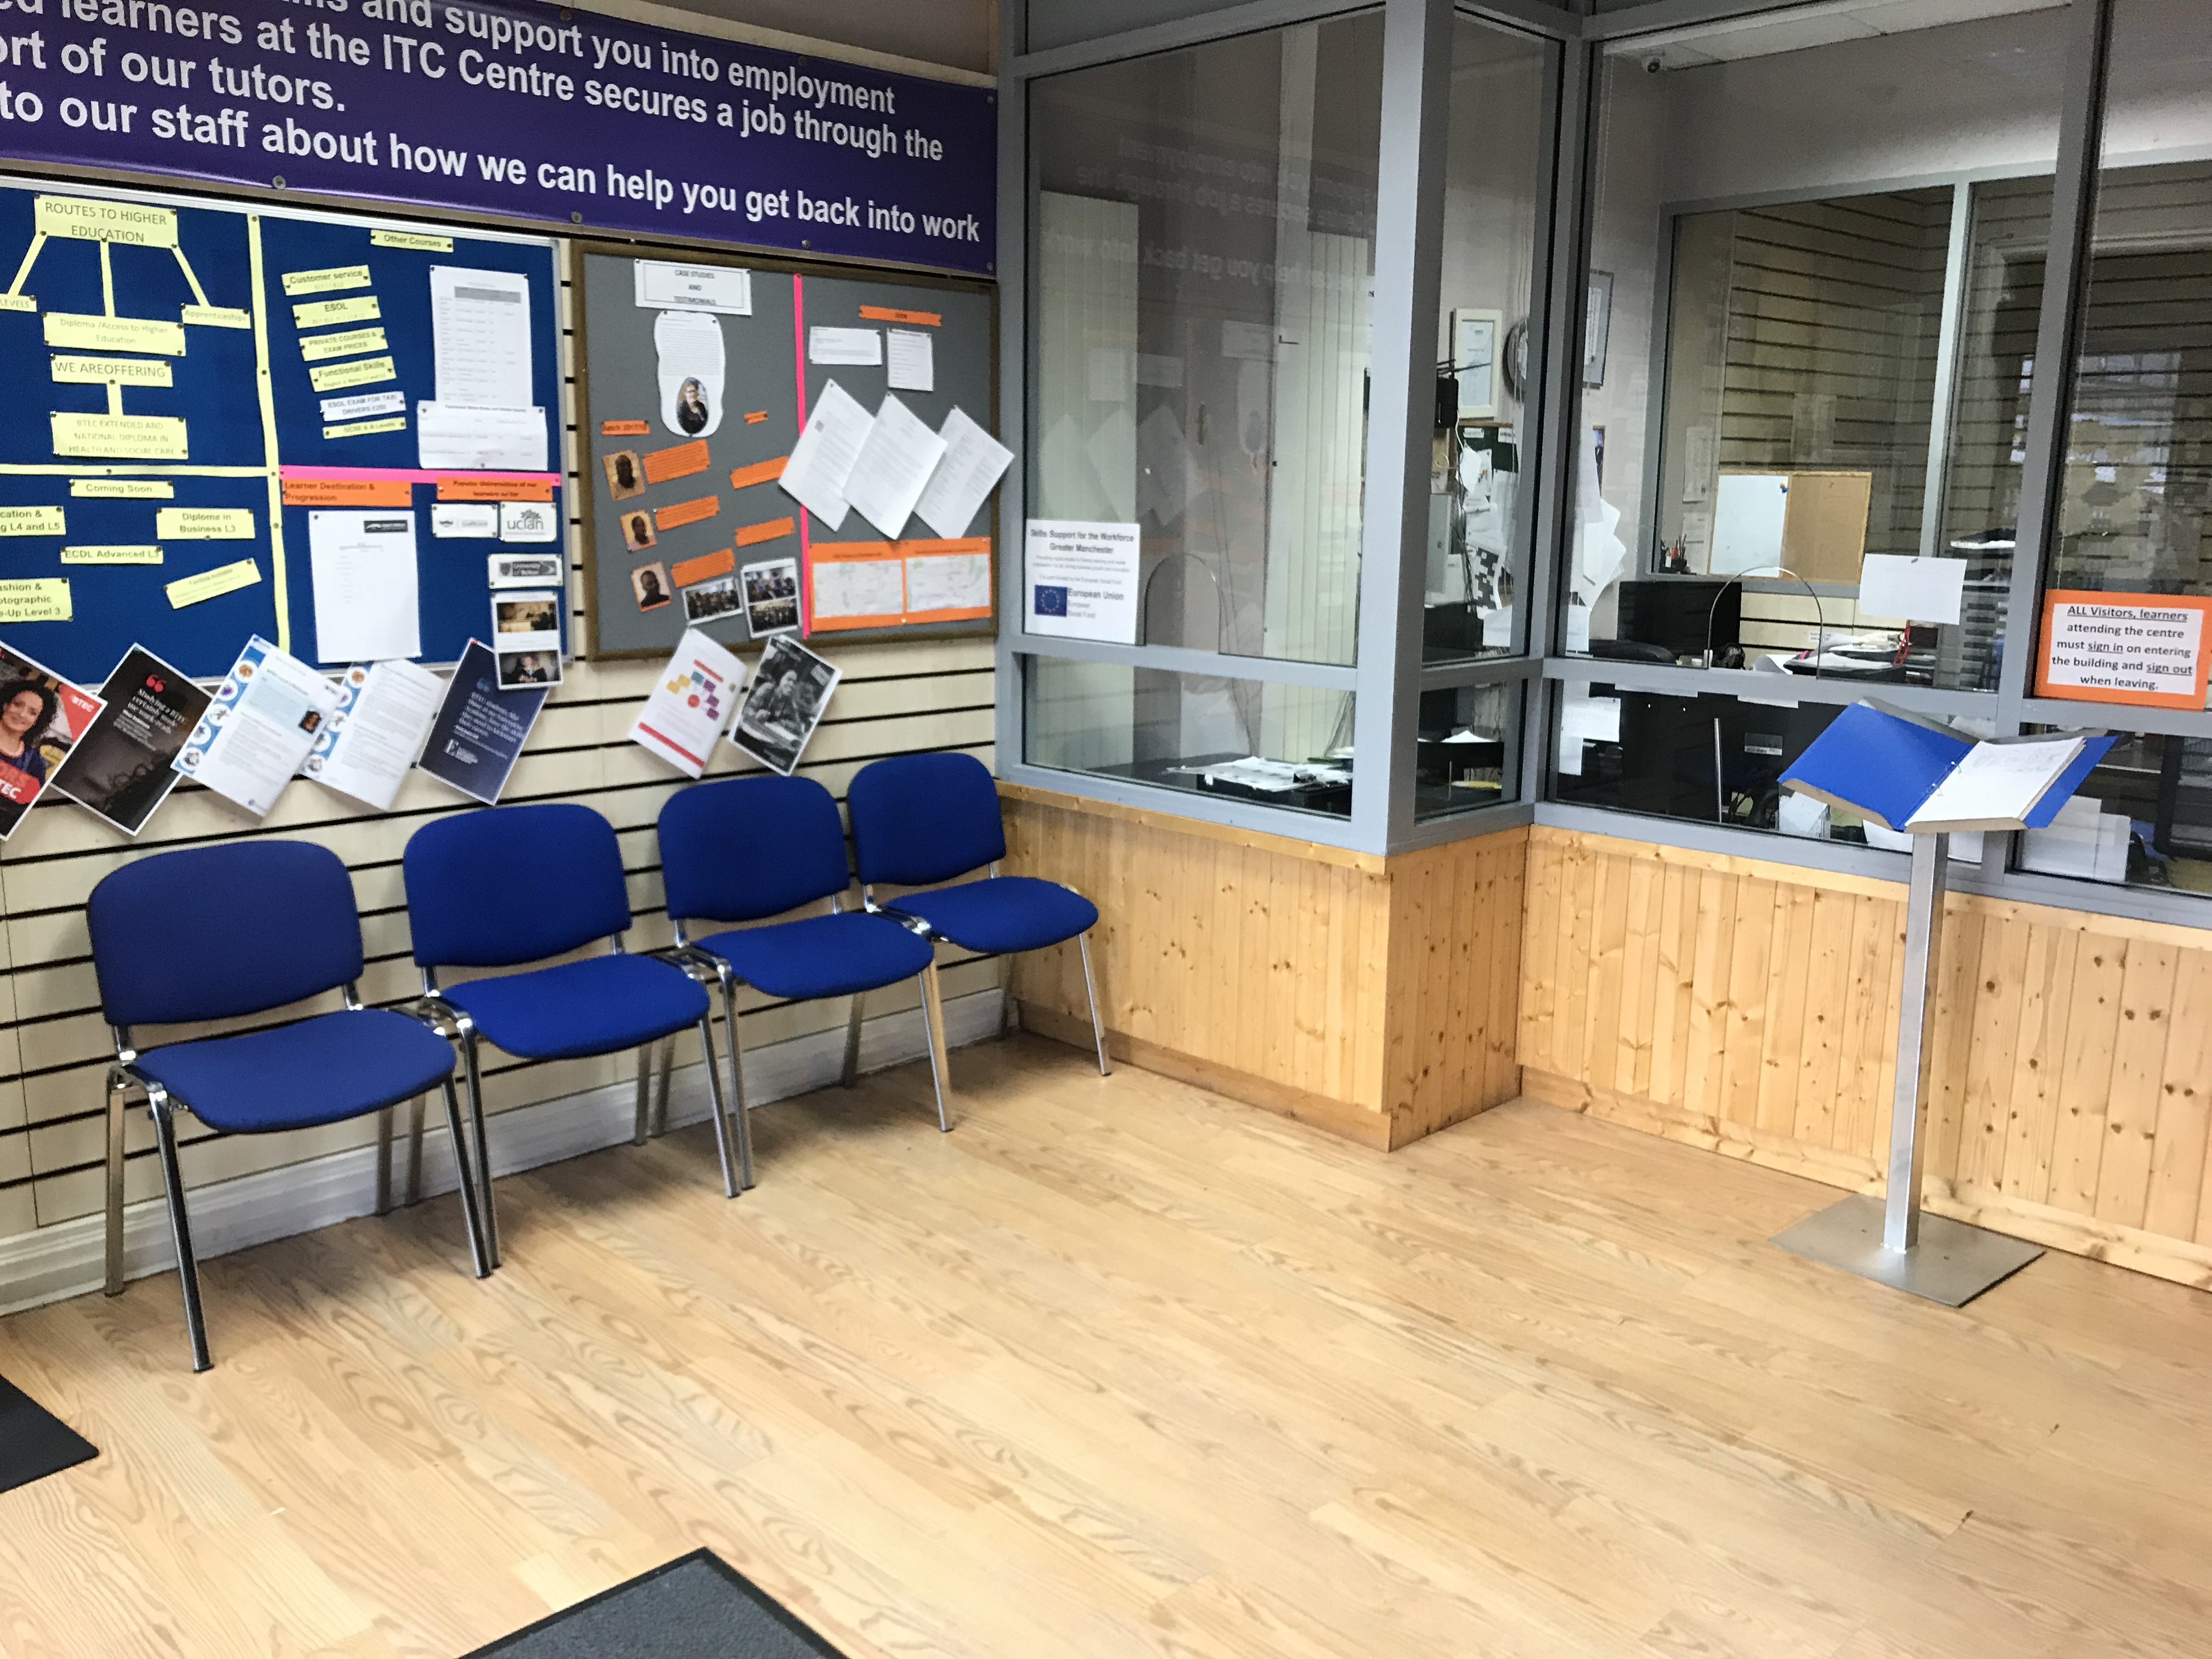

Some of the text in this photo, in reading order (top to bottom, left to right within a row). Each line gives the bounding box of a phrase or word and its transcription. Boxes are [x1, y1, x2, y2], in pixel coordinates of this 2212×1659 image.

[362, 0, 895, 115] and support you into employment
[0, 31, 346, 111] rt of our tutors.
[257, 18, 295, 53] at
[307, 22, 370, 65] the
[383, 34, 445, 78] ITC
[459, 49, 574, 100] Centre
[585, 81, 707, 122] secures
[717, 104, 733, 127] a
[740, 99, 786, 137] job
[794, 110, 896, 158] through
[905, 129, 943, 160] the
[0, 81, 979, 241] to our staff about how we can help you get back into work
[46, 202, 167, 225] ROUTES TO HIGHER
[71, 225, 144, 242] EDUCATION
[384, 234, 441, 247] Other Courses
[290, 270, 363, 284] Customer service
[324, 302, 348, 312] ESOL
[60, 319, 95, 328] Diploma
[142, 326, 167, 334] Higher
[97, 335, 136, 344] Education
[309, 337, 337, 345] PRIVATE
[339, 332, 370, 341] COURSES
[324, 341, 368, 353] EXAM PRICES
[55, 362, 165, 377] WE AREOFFERING
[319, 360, 384, 377] Functional Skills
[100, 420, 143, 429] EXTENDED
[74, 433, 115, 441] NATIONAL
[119, 434, 157, 442] DIPLOMA
[69, 445, 101, 454] HEALTH
[86, 483, 124, 494] Coming
[35, 510, 42, 518] &
[182, 513, 220, 522] Diploma
[10, 523, 22, 531] L4
[48, 522, 60, 531] L5
[179, 525, 236, 534] Business L3
[1049, 530, 1076, 539] Support
[1100, 533, 1135, 542] Workforce
[65, 550, 93, 559] ECDL
[97, 550, 145, 558] Advanced
[1049, 543, 1113, 554] Greater Manchester
[35, 583, 42, 591] &
[1068, 588, 1124, 601] European Union
[25, 608, 52, 617] Level
[55, 607, 60, 616] 3
[2067, 606, 2188, 620] ALL Visitors, learners
[2067, 624, 2185, 639] attending the centre
[2057, 641, 2191, 659] must sign in on entering
[2052, 656, 2193, 674] the building and sign out
[2080, 675, 2158, 691] when leaving.
